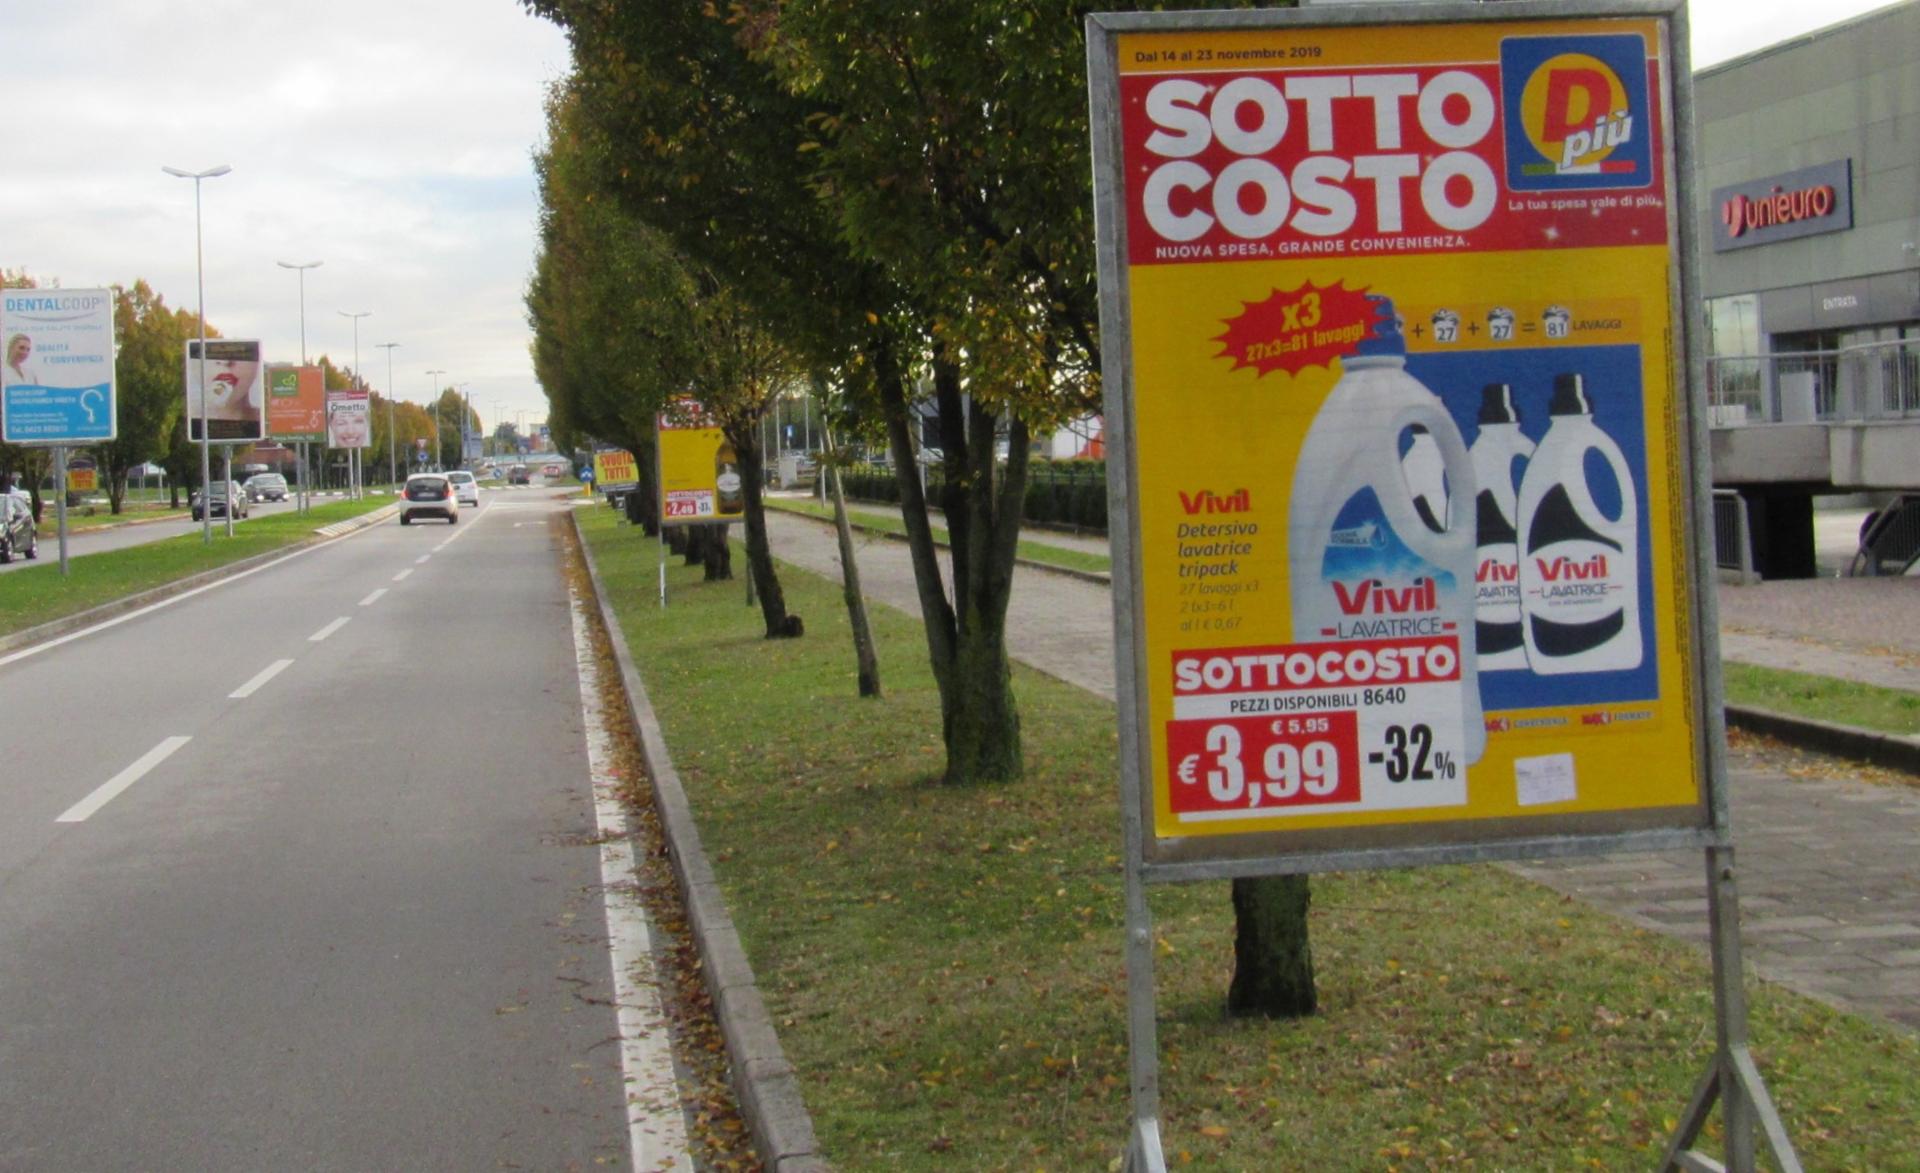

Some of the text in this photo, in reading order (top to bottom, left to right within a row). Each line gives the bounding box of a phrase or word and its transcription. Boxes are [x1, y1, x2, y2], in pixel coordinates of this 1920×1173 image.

[1135, 46, 1322, 63] Dal 14 al 23 novembre 2019
[1144, 70, 1496, 158] SOTTO
[1541, 68, 1612, 145] D
[1559, 110, 1633, 170] più
[1143, 150, 1497, 242] COSTO
[1508, 199, 1524, 211] La
[1527, 199, 1548, 210] tua
[1551, 199, 1587, 211] spesa
[1590, 196, 1617, 208] vale
[1620, 195, 1633, 207] di
[1745, 184, 1836, 229] unieuro
[1156, 235, 1471, 259] NUOVA SPESA, GRANDE CONVENIENZA.
[6, 297, 99, 312] DENTALCOOP
[1281, 291, 1321, 333] x3
[1246, 320, 1366, 363] 27x3=81 lavaggi
[1437, 327, 1455, 341] 27
[1493, 325, 1510, 339] 27
[1547, 322, 1566, 337] 81
[1572, 319, 1622, 332] LAVAGGI
[604, 467, 631, 481] TUTTO
[1178, 488, 1251, 516] Vivil
[1177, 520, 1258, 539] Detersivo
[1178, 541, 1252, 558] lavatrice
[1178, 560, 1238, 579] tripack
[1536, 554, 1608, 582] Vivil
[1199, 581, 1243, 596] lavaggi
[1332, 577, 1437, 615] Vivil
[1541, 583, 1609, 599] LAVATRICE
[1338, 617, 1442, 640] LAVATRICE
[1175, 645, 1456, 692] SOTTOCOSTO
[1230, 687, 1406, 713] PEZZI DISPONIBILI 8640
[1271, 718, 1329, 735] € 5.95
[1178, 724, 1339, 808] € 3,99
